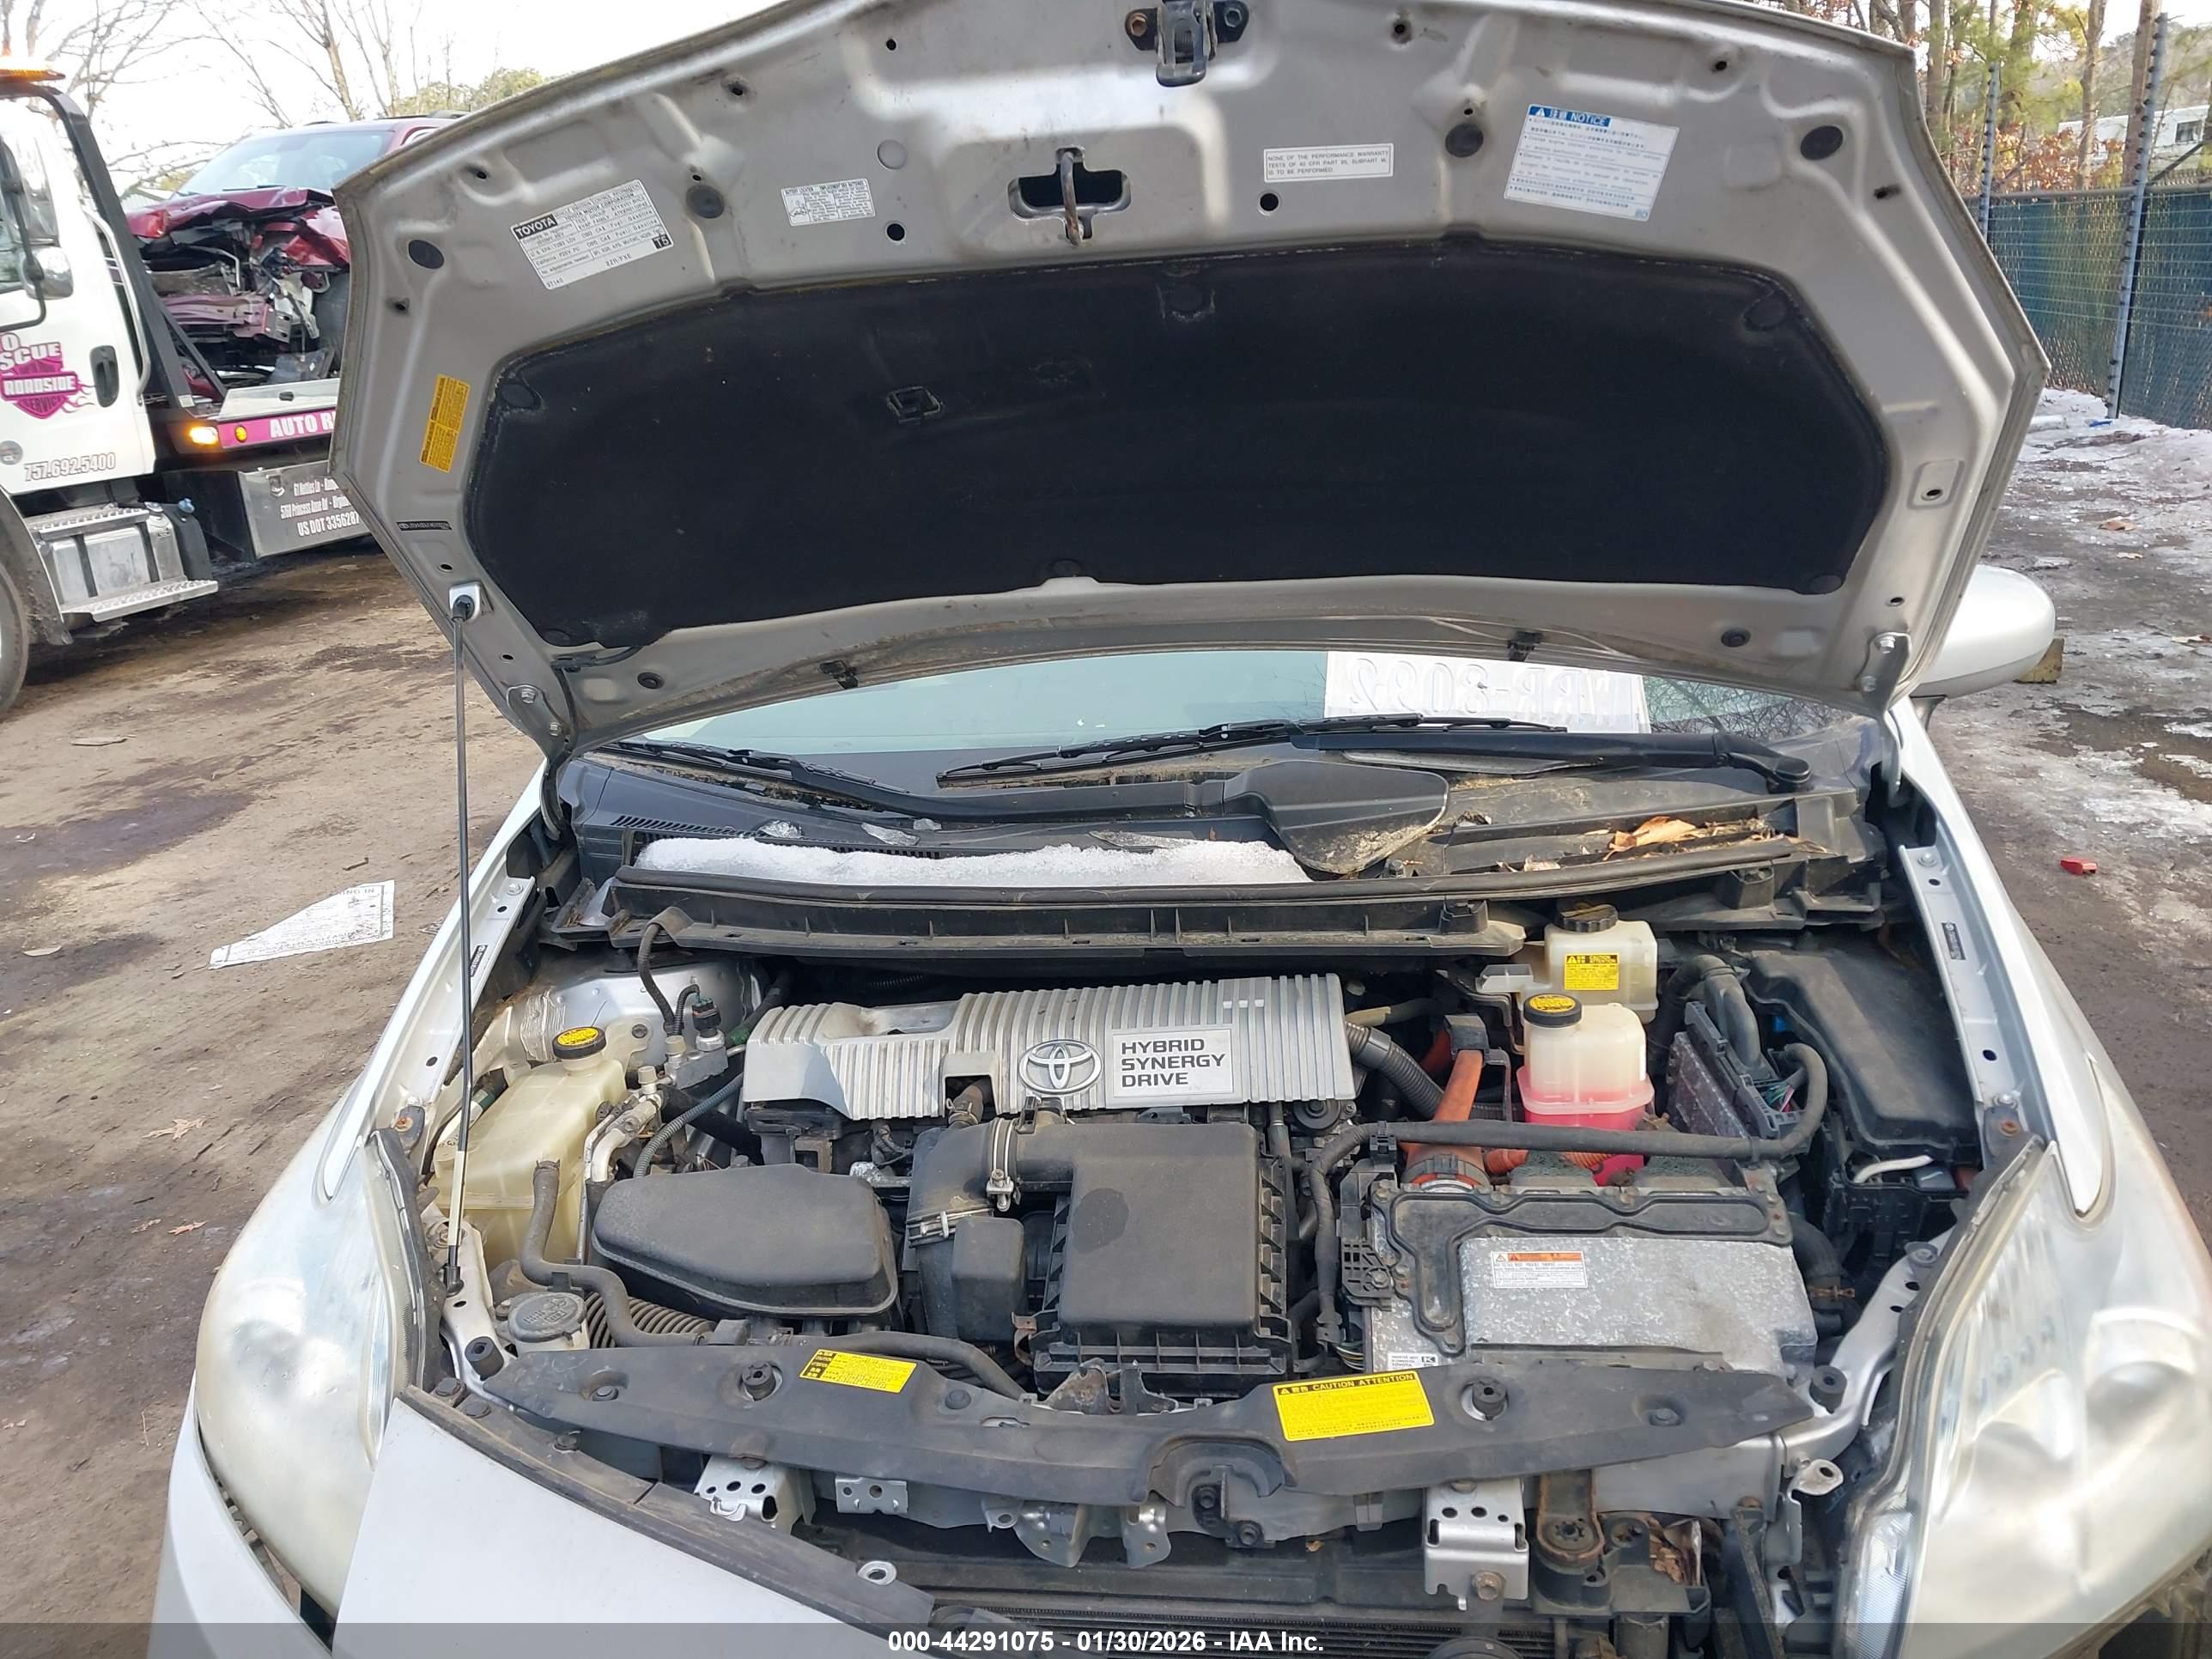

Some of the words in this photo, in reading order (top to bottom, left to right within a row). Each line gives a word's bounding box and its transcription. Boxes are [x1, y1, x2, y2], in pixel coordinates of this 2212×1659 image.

[1571, 112, 1606, 126] NOTICE
[1312, 151, 1354, 160] PERFORMANCE
[515, 216, 556, 237] TOYOTA
[270, 414, 318, 438] AUTO
[24, 452, 116, 482] 757.692.5400
[297, 521, 310, 537] US
[310, 518, 325, 534] DOT
[326, 511, 360, 531] 3356287
[1121, 1038, 1205, 1054] HYBRID
[1121, 1054, 1225, 1071] SYNERGY
[1121, 1072, 1188, 1088] DRIVE
[1312, 1380, 1355, 1391] CAUTION
[1359, 1375, 1413, 1386] ATTENTION
